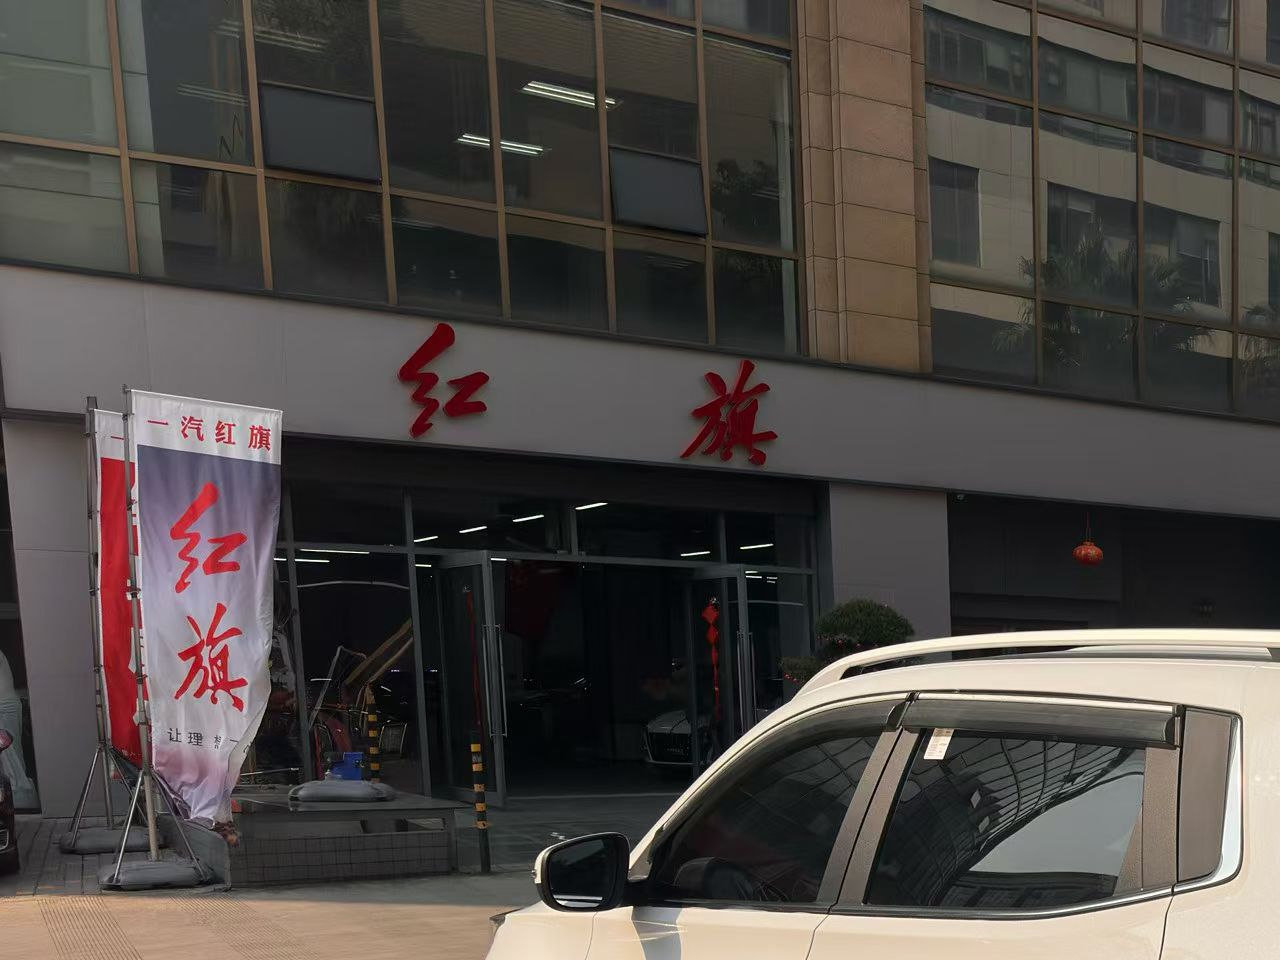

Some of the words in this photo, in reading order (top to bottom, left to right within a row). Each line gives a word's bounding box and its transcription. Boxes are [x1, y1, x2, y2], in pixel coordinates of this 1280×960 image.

[147, 415, 272, 451] 一汽红旗
[397, 322, 778, 465] 红旗
[169, 482, 249, 713] 红旗
